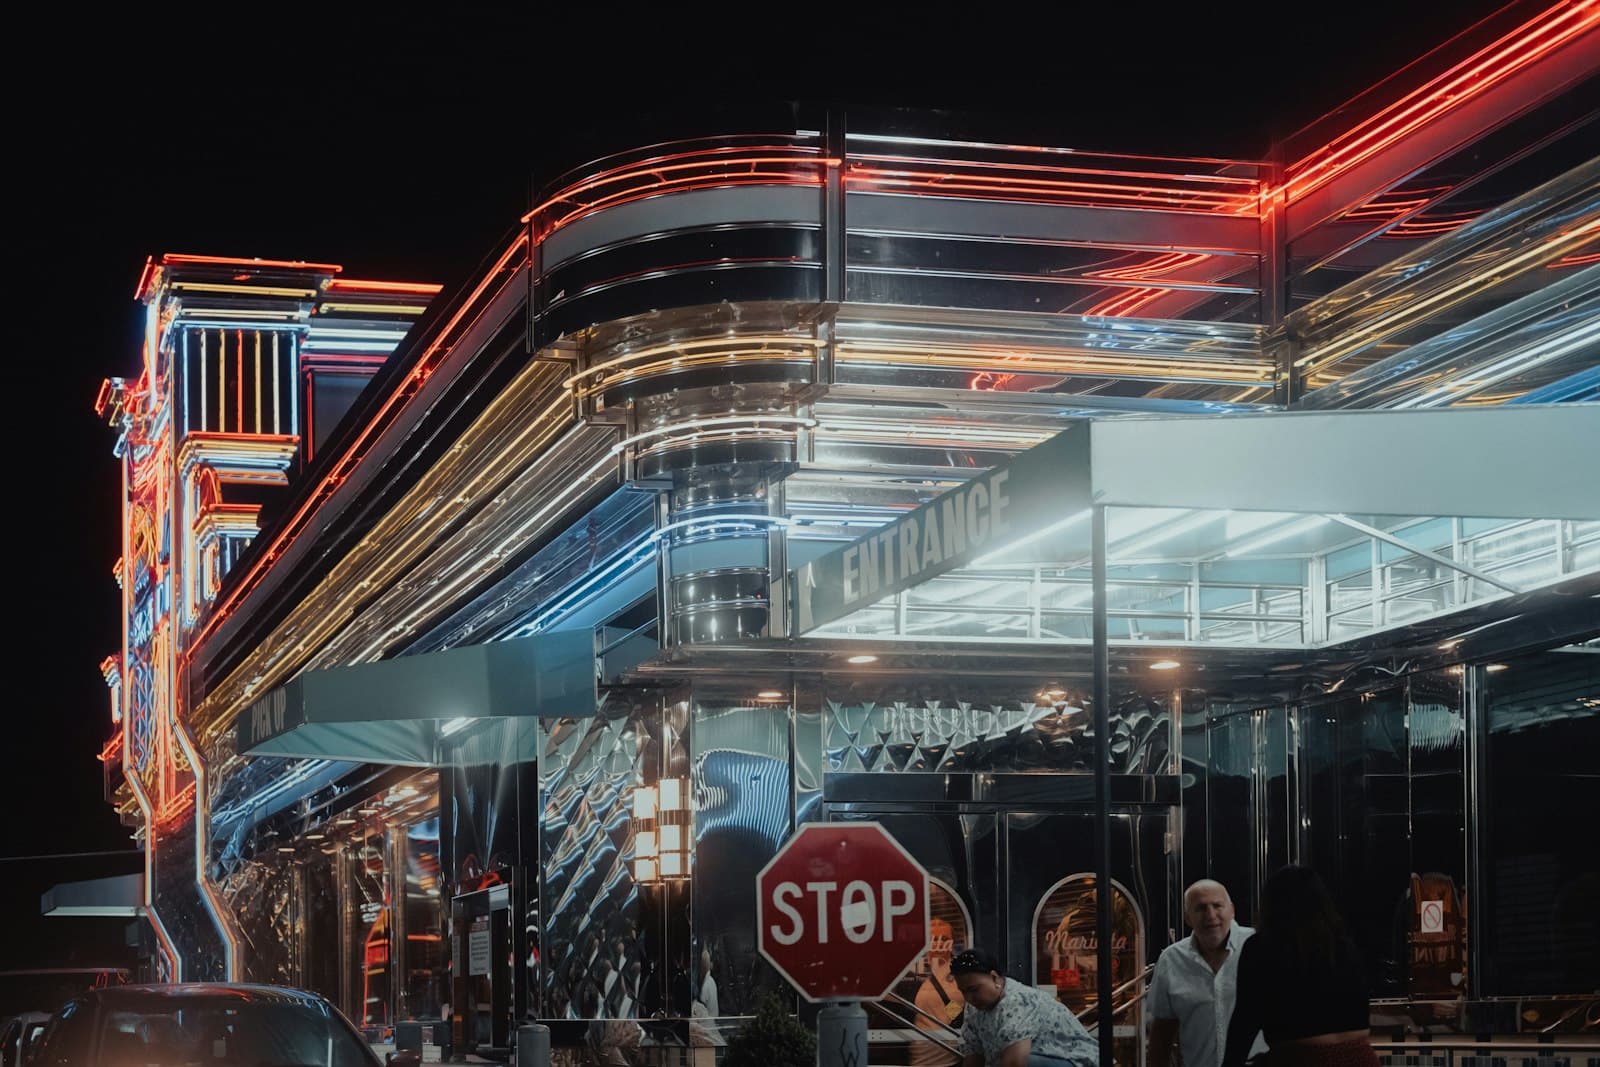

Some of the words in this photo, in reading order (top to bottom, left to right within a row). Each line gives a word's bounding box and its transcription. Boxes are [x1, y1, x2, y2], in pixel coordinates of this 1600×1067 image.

[843, 470, 1009, 604] ENTRANCE
[252, 693, 272, 743] PICK
[274, 686, 286, 733] UP
[770, 880, 916, 945] STOP
